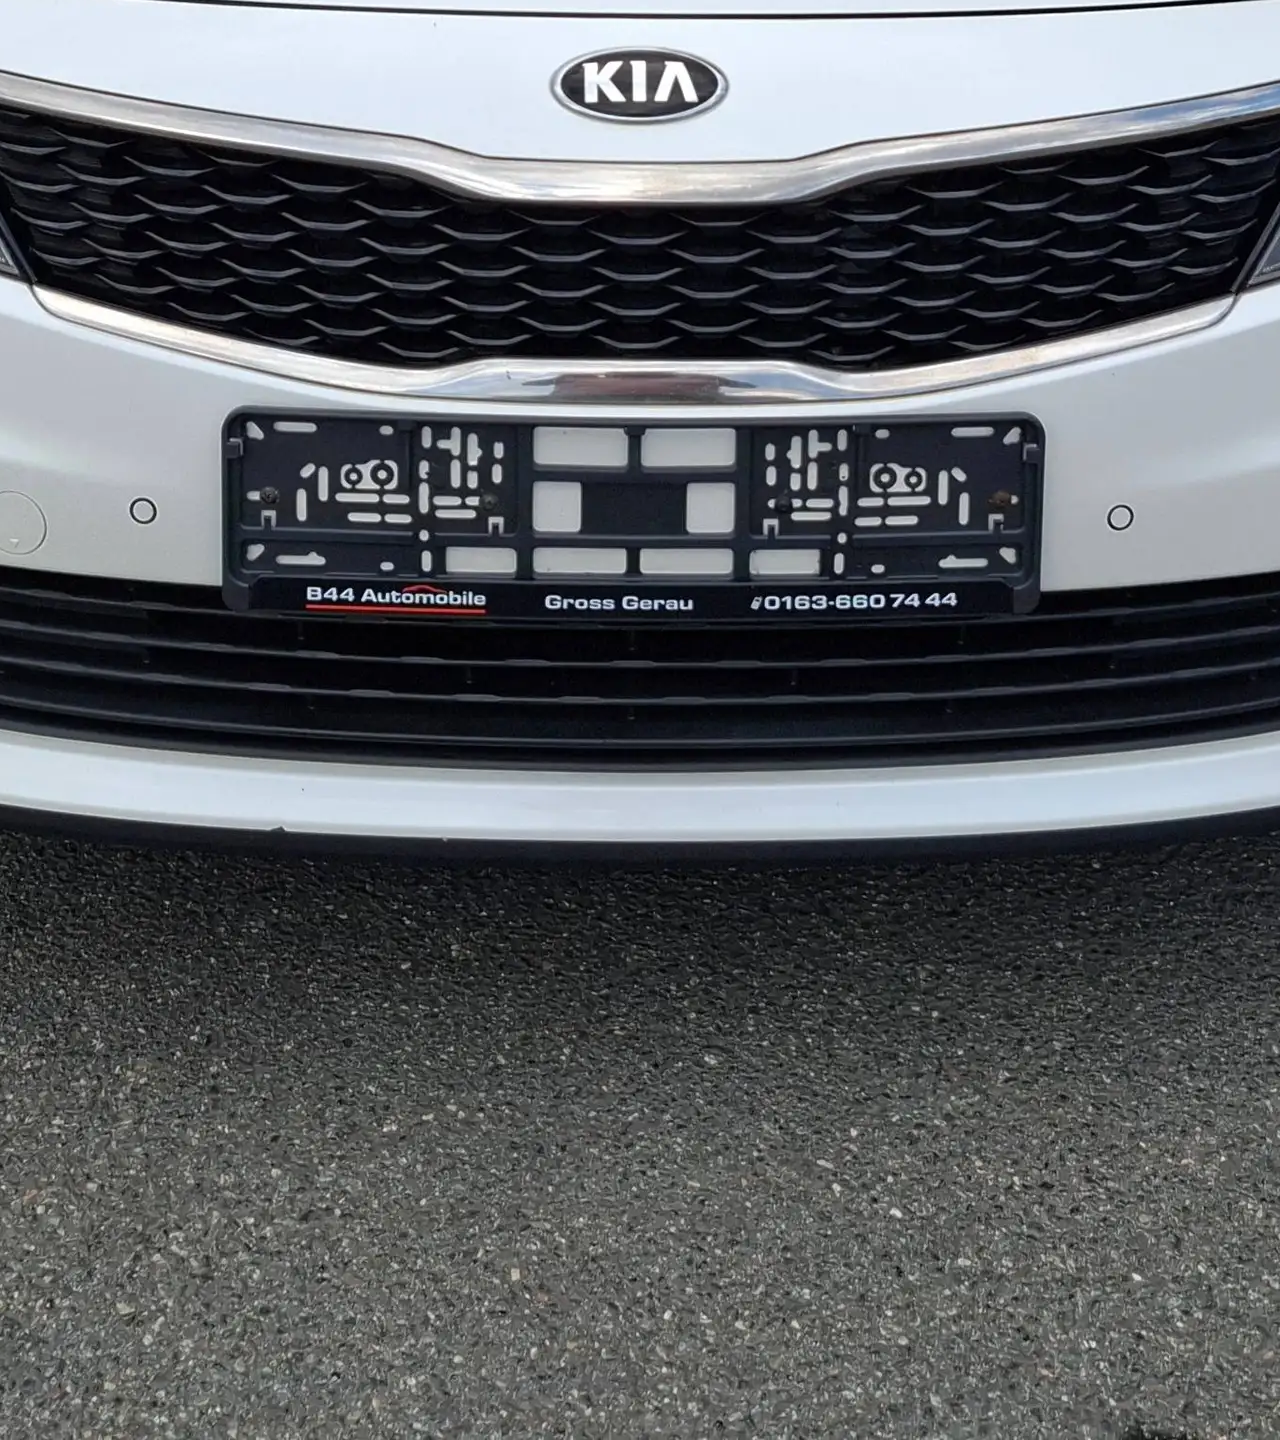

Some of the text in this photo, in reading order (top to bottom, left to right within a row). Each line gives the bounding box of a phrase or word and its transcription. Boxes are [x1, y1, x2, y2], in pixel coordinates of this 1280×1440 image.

[582, 60, 699, 104] KIA
[306, 586, 487, 606] B44 Automobile
[544, 595, 694, 611] Gross Gerau
[764, 592, 958, 610] 0163-660 74 44
